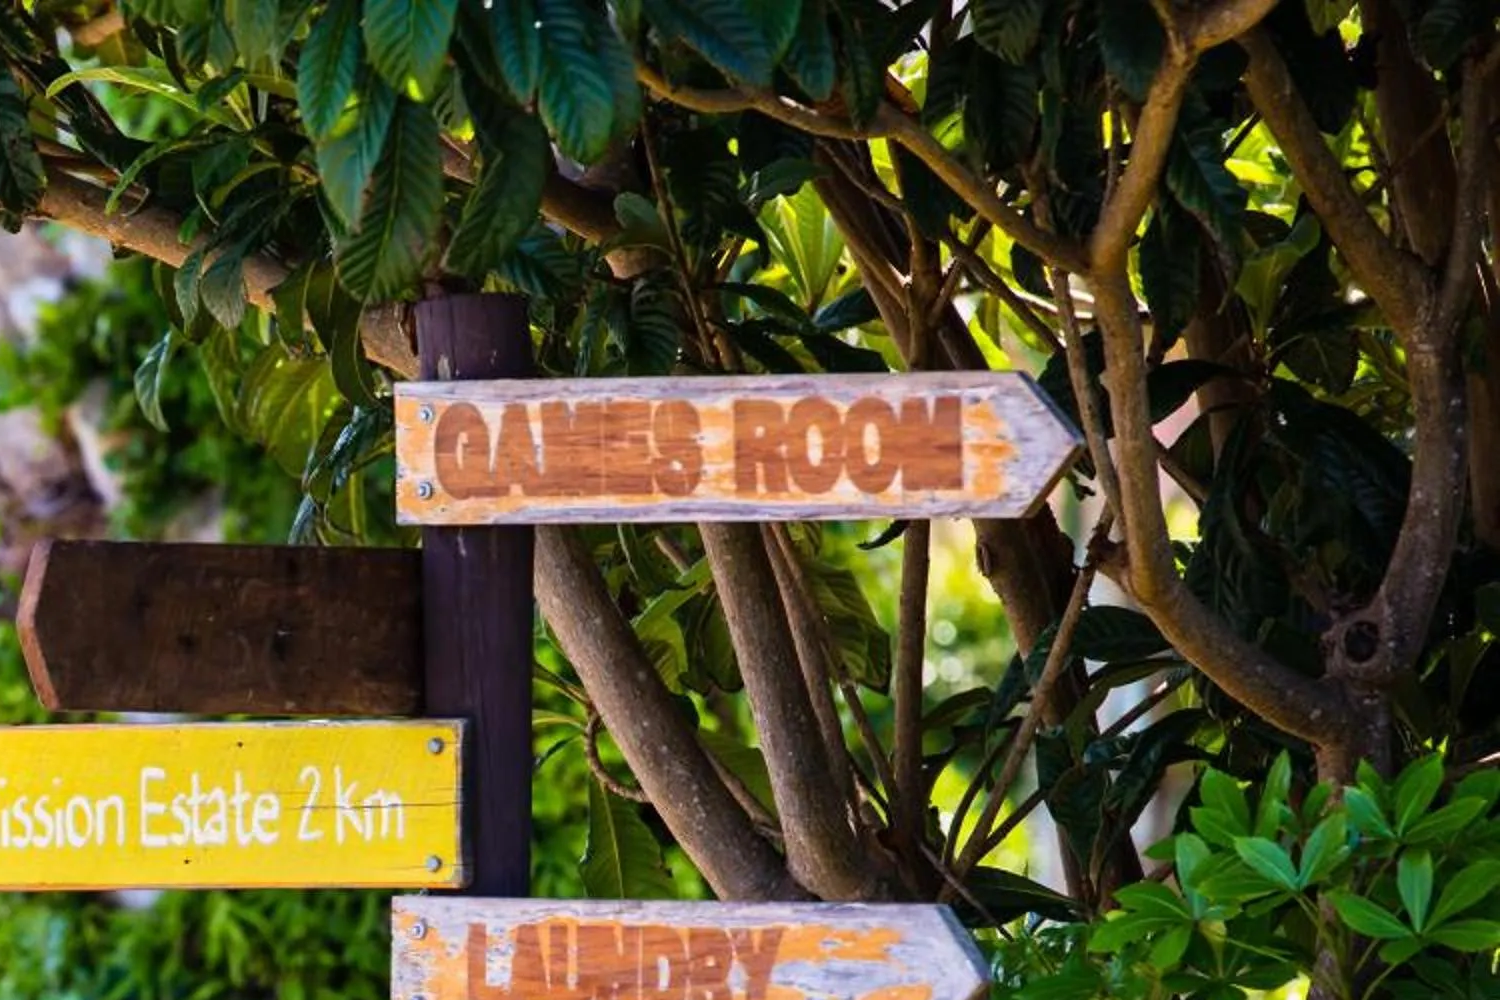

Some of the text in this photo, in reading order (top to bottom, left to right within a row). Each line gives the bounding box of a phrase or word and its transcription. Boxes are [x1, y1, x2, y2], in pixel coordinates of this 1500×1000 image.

[434, 397, 964, 499] GAMES ROOM
[140, 767, 281, 848] Estate
[298, 766, 322, 842] 2
[334, 766, 407, 844] km
